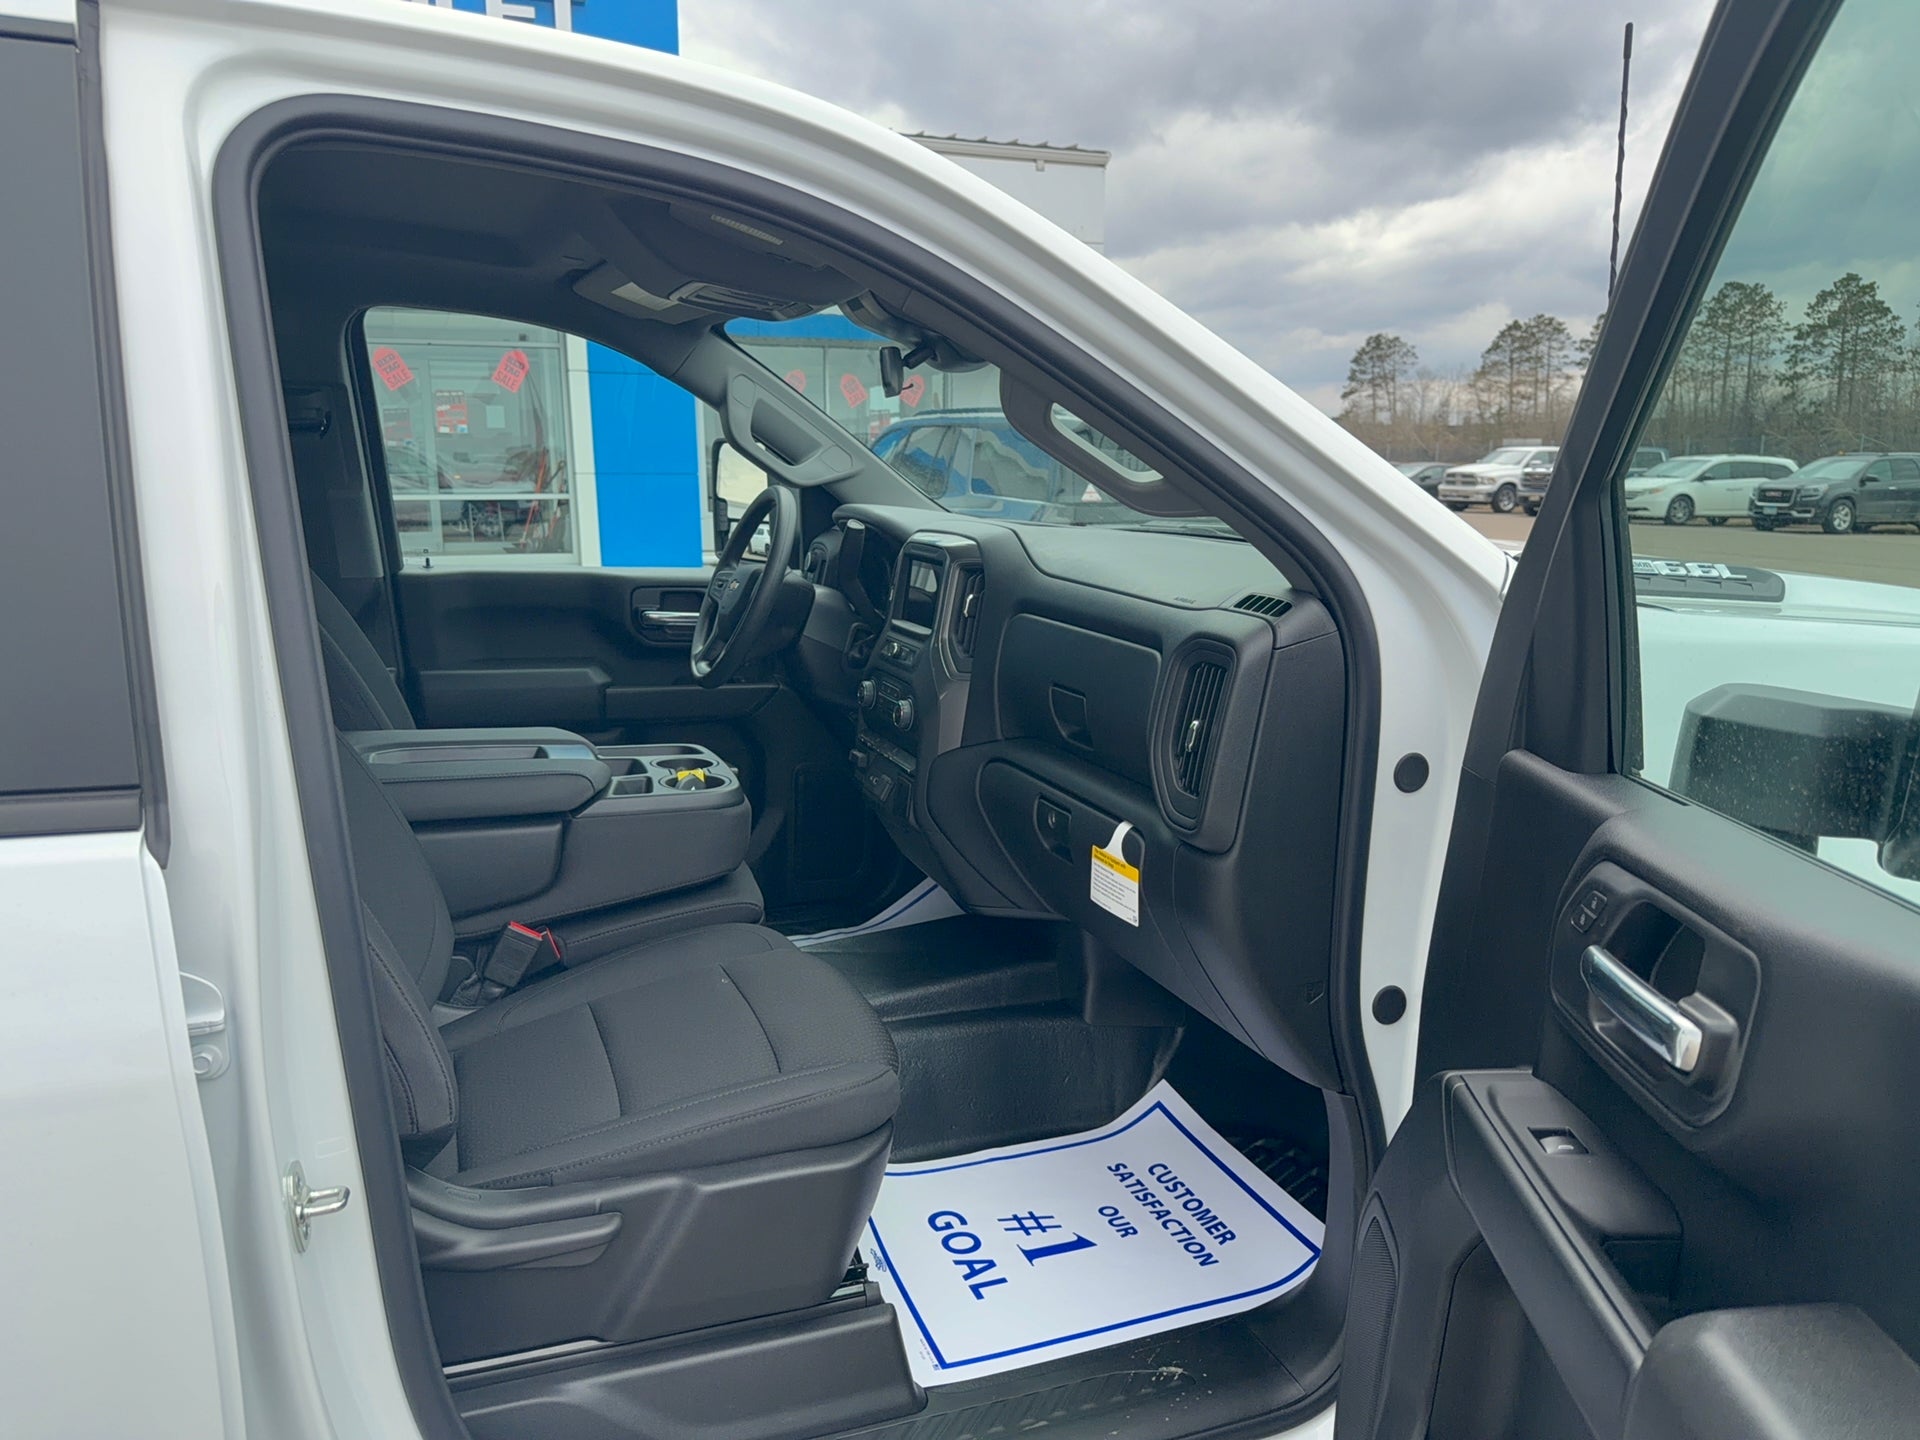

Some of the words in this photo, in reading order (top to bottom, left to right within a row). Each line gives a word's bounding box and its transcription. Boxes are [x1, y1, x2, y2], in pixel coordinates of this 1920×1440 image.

[387, 368, 412, 388] SALE
[494, 371, 518, 390] SALE
[1097, 1204, 1139, 1239] OUR
[1107, 1162, 1220, 1268] SATISFACTION
[1147, 1162, 1237, 1246] CUSTOMER
[927, 1209, 1008, 1300] GOAL
[997, 1210, 1098, 1266] #1
